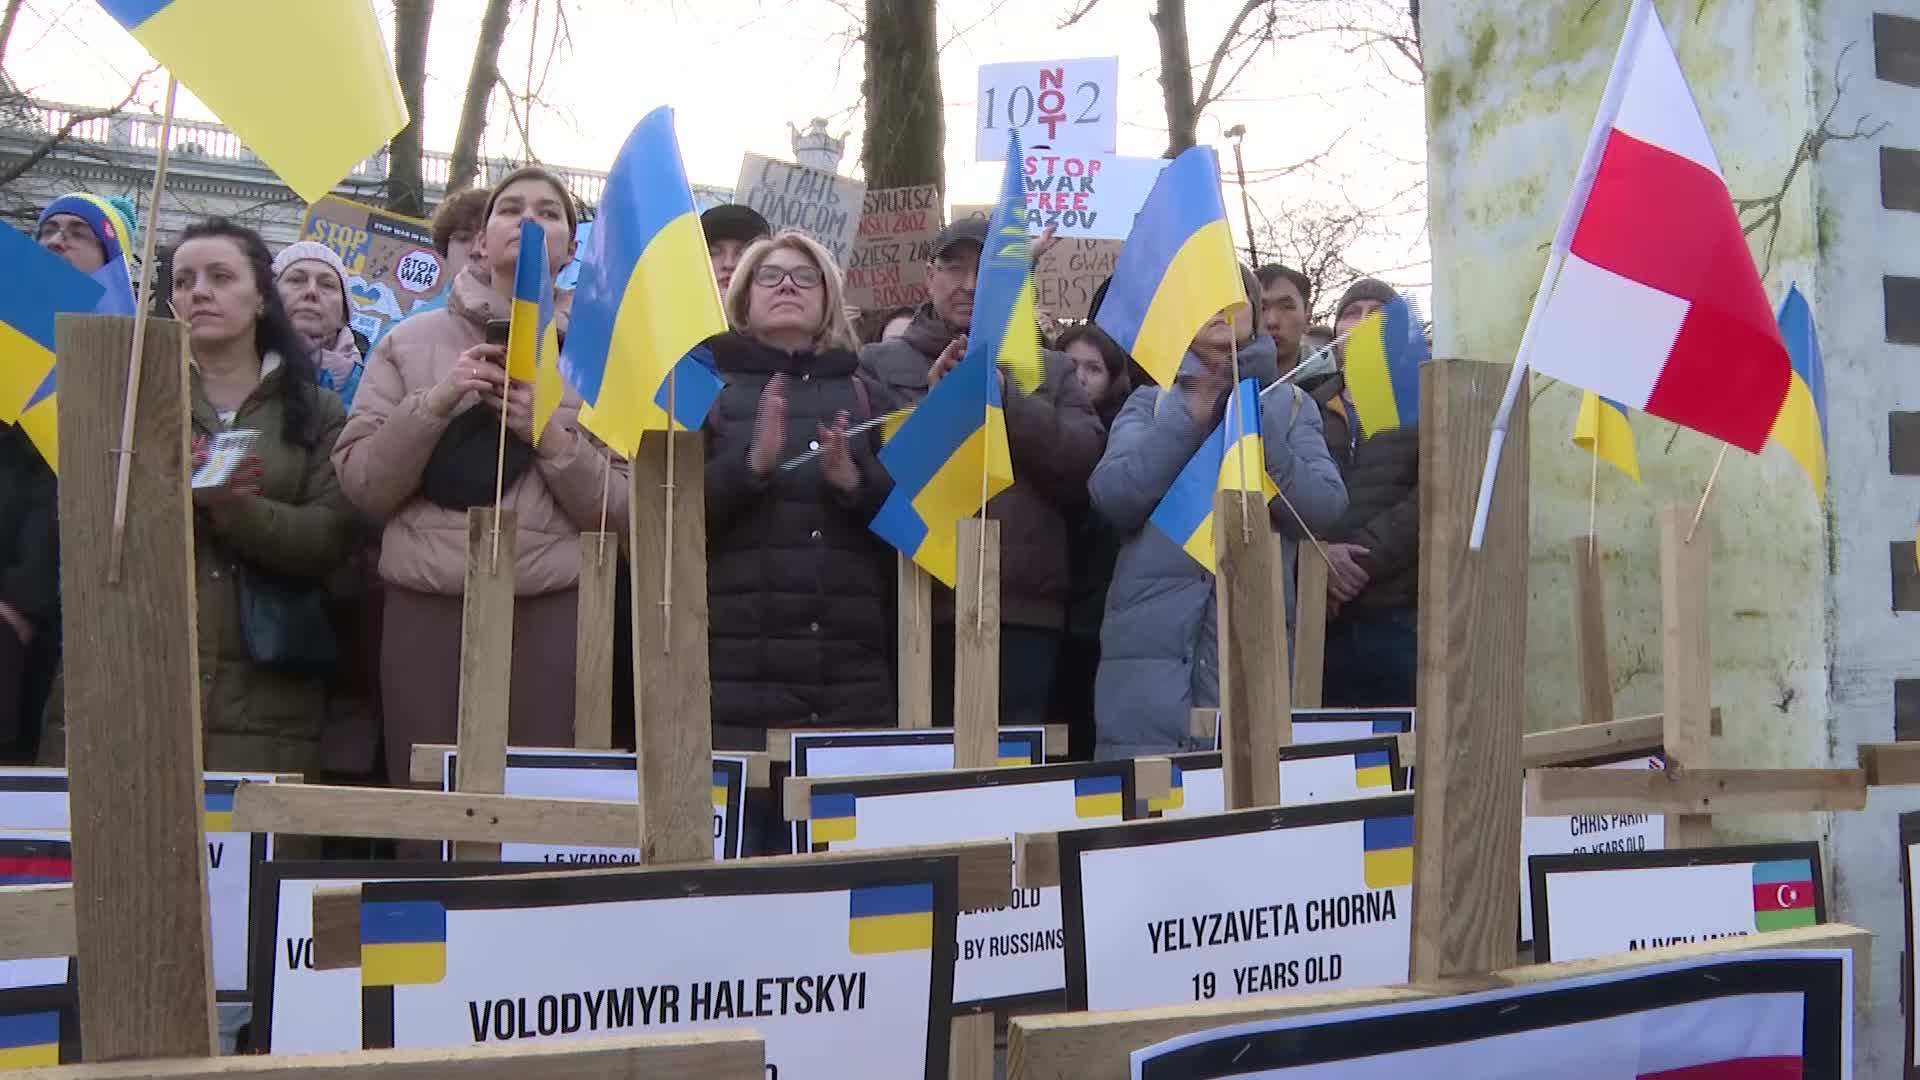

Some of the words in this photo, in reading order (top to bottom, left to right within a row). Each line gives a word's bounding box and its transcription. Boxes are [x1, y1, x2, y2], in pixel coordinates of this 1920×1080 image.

[1037, 66, 1067, 140] NOT
[1024, 155, 1102, 177] STOP
[1025, 176, 1095, 193] WAR
[1024, 192, 1089, 211] FREE
[1025, 208, 1097, 230] AZOV
[308, 219, 368, 252] STOP
[374, 223, 393, 234] STOP
[394, 228, 411, 238] WAR
[404, 257, 438, 273] STOP
[400, 266, 433, 287] WAR
[1570, 814, 1608, 836] CHRIS
[1011, 888, 1041, 910] OLD
[1147, 902, 1300, 955] YELYZAVETA
[1306, 889, 1397, 933] CHORNA
[964, 938, 985, 960] BY
[989, 928, 1065, 958] RUSSIANS
[1192, 971, 1217, 1001] 19
[1233, 960, 1299, 995] YEARS
[1305, 953, 1342, 985] OLD
[469, 984, 680, 1043] VOLODYMYR
[690, 971, 867, 1022] HALETSKYI
